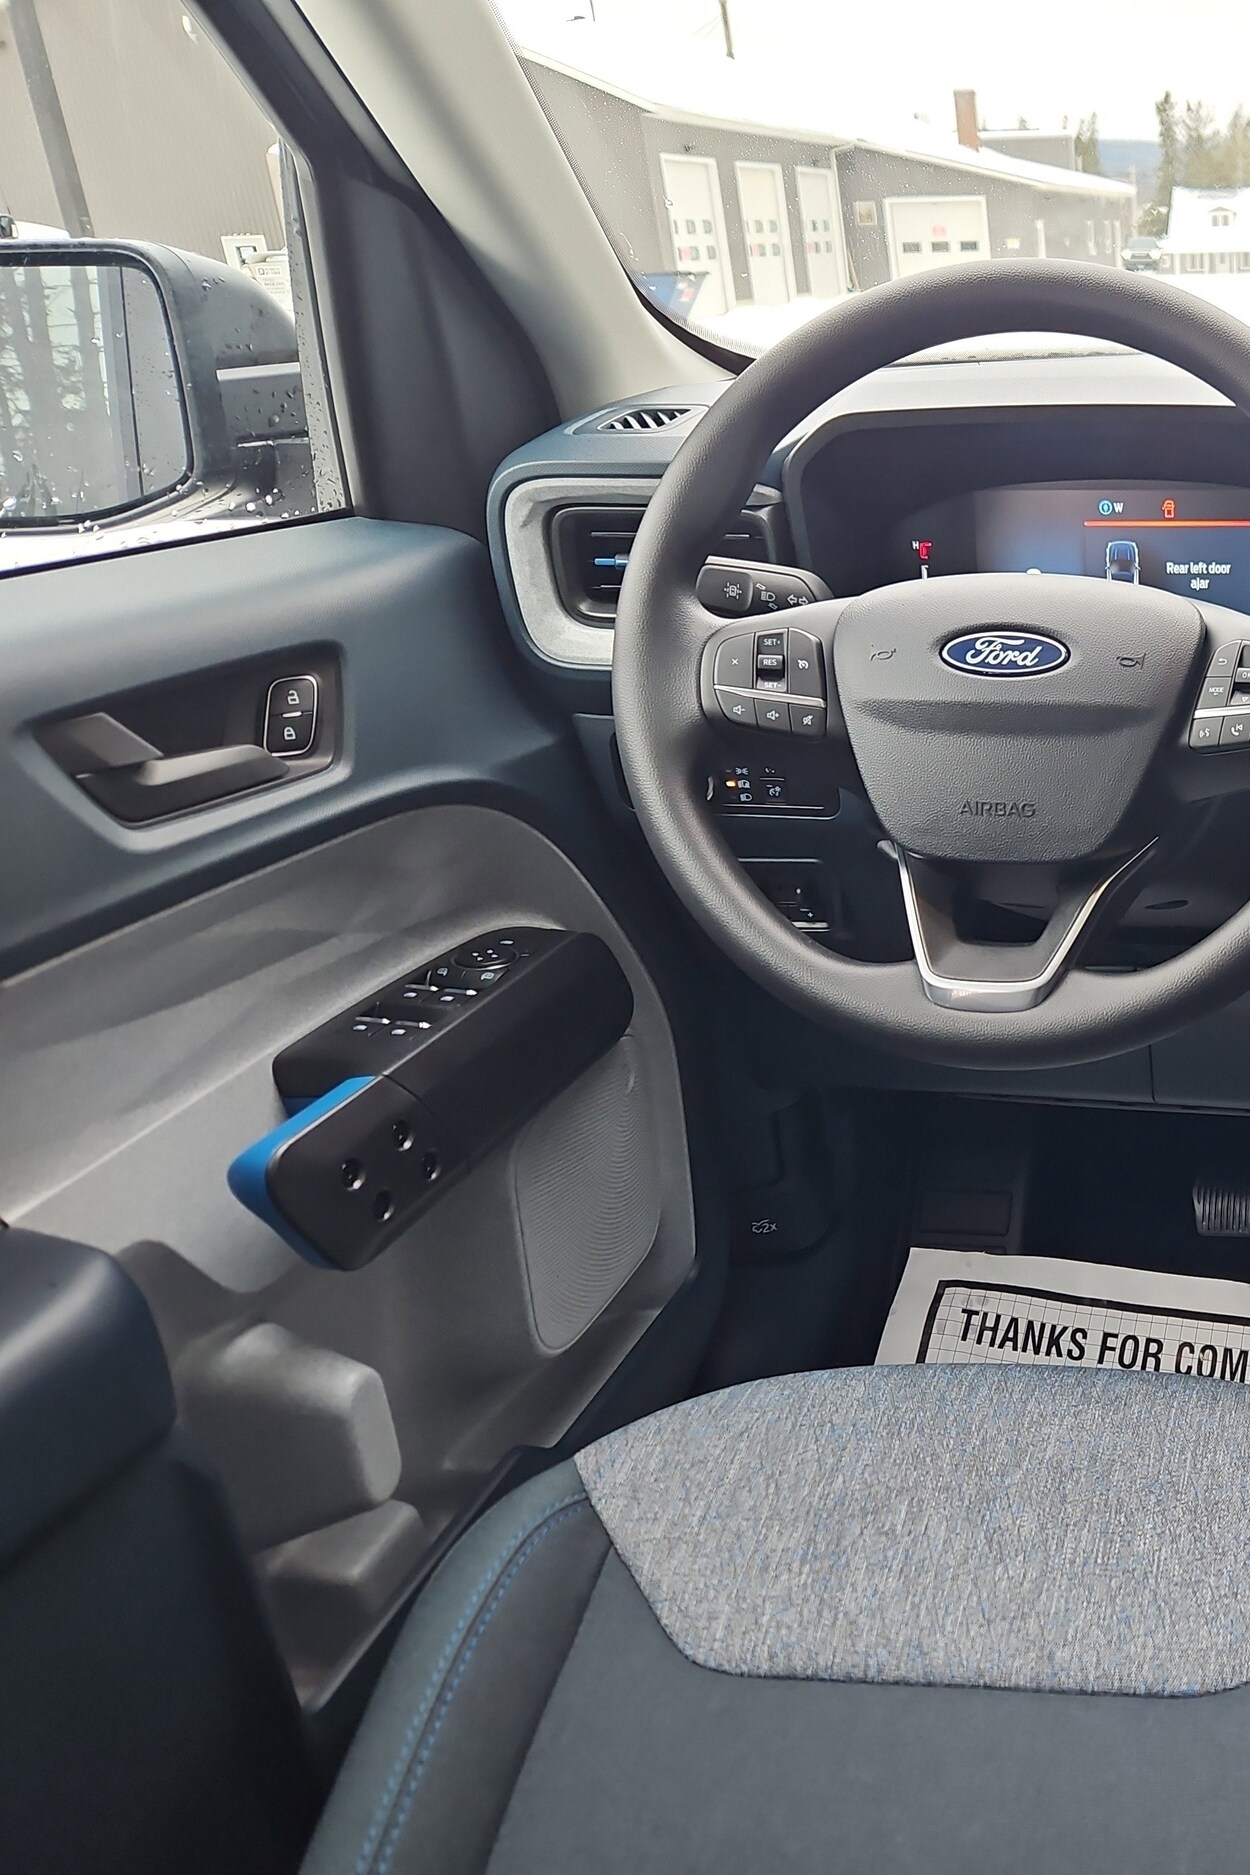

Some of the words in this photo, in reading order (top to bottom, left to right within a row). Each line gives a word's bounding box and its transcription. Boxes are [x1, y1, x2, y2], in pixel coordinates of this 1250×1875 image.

[1113, 502, 1124, 514] W
[1166, 562, 1188, 574] Rear
[1190, 561, 1207, 574] left
[1208, 562, 1231, 574] door
[1190, 578, 1210, 590] ajar
[965, 636, 1043, 667] Ford
[763, 658, 778, 666] RES
[959, 800, 1037, 818] AIRBAG
[960, 1307, 1089, 1361] THANKS
[1096, 1332, 1164, 1372] FOR
